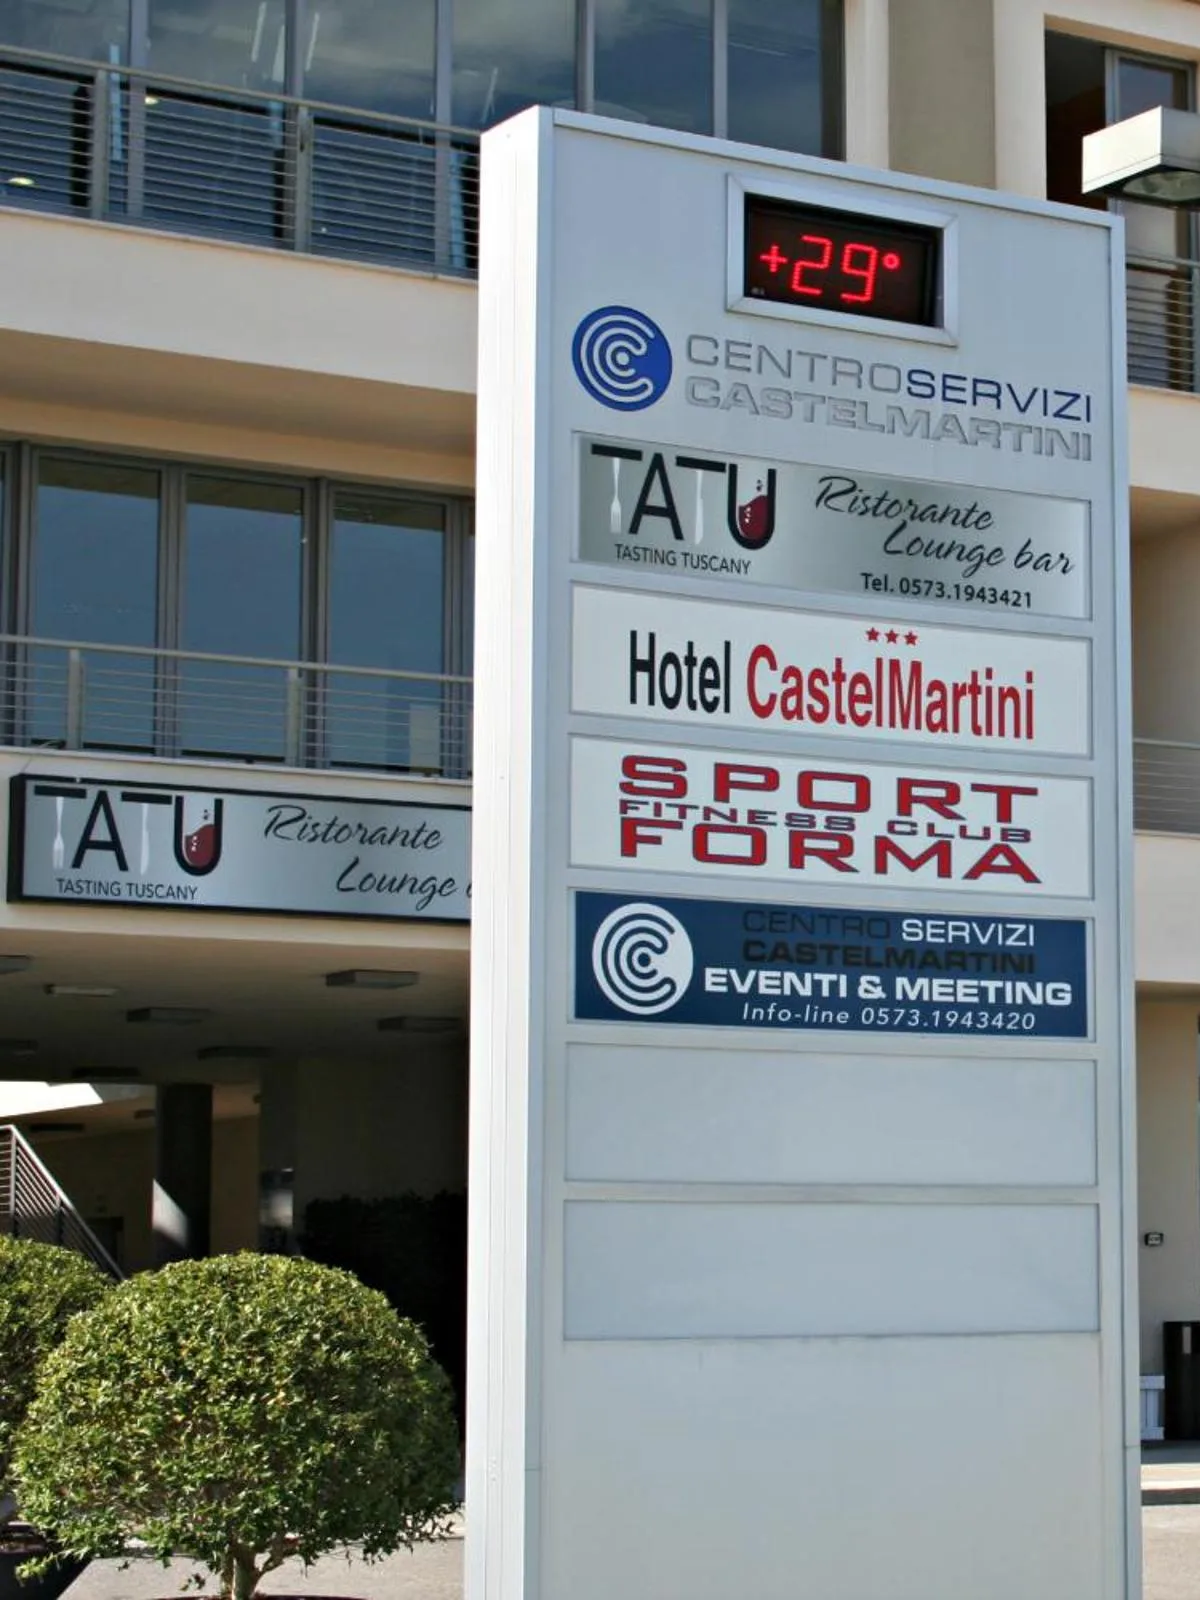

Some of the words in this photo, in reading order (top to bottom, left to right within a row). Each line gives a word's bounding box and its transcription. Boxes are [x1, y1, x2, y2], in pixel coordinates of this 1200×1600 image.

[685, 376, 1092, 461] CASTELMARTINI
[590, 444, 777, 551] TATU
[813, 476, 994, 531] Ristorante
[615, 543, 677, 567] TASTING
[681, 553, 751, 575] TUSCANY
[884, 520, 1005, 578] Lounge
[1014, 539, 1075, 575] bar
[861, 572, 894, 594] Tel.
[899, 577, 1032, 609] 0573.1943421
[629, 630, 731, 713] Hotel
[747, 645, 1034, 740] CastelMartini
[619, 755, 1039, 824] SPORT
[34, 785, 224, 877] TATU
[264, 805, 443, 850] Ristorante
[619, 800, 856, 831] FITNESS
[886, 820, 1031, 843] CLUB
[620, 817, 1042, 884] FORMA
[56, 877, 121, 898] TASTING
[127, 881, 198, 901] TUSCANY
[336, 855, 457, 911] Lounge
[742, 910, 890, 940] CENTRO
[902, 920, 1035, 947] SERVIZI
[742, 940, 1036, 974] CASTELMARTINI
[704, 967, 848, 999] EVENTI
[857, 976, 887, 999] &
[895, 978, 1073, 1006] MEETING
[742, 1003, 850, 1026] Info-line
[861, 1008, 1036, 1030] 0573.1943420
